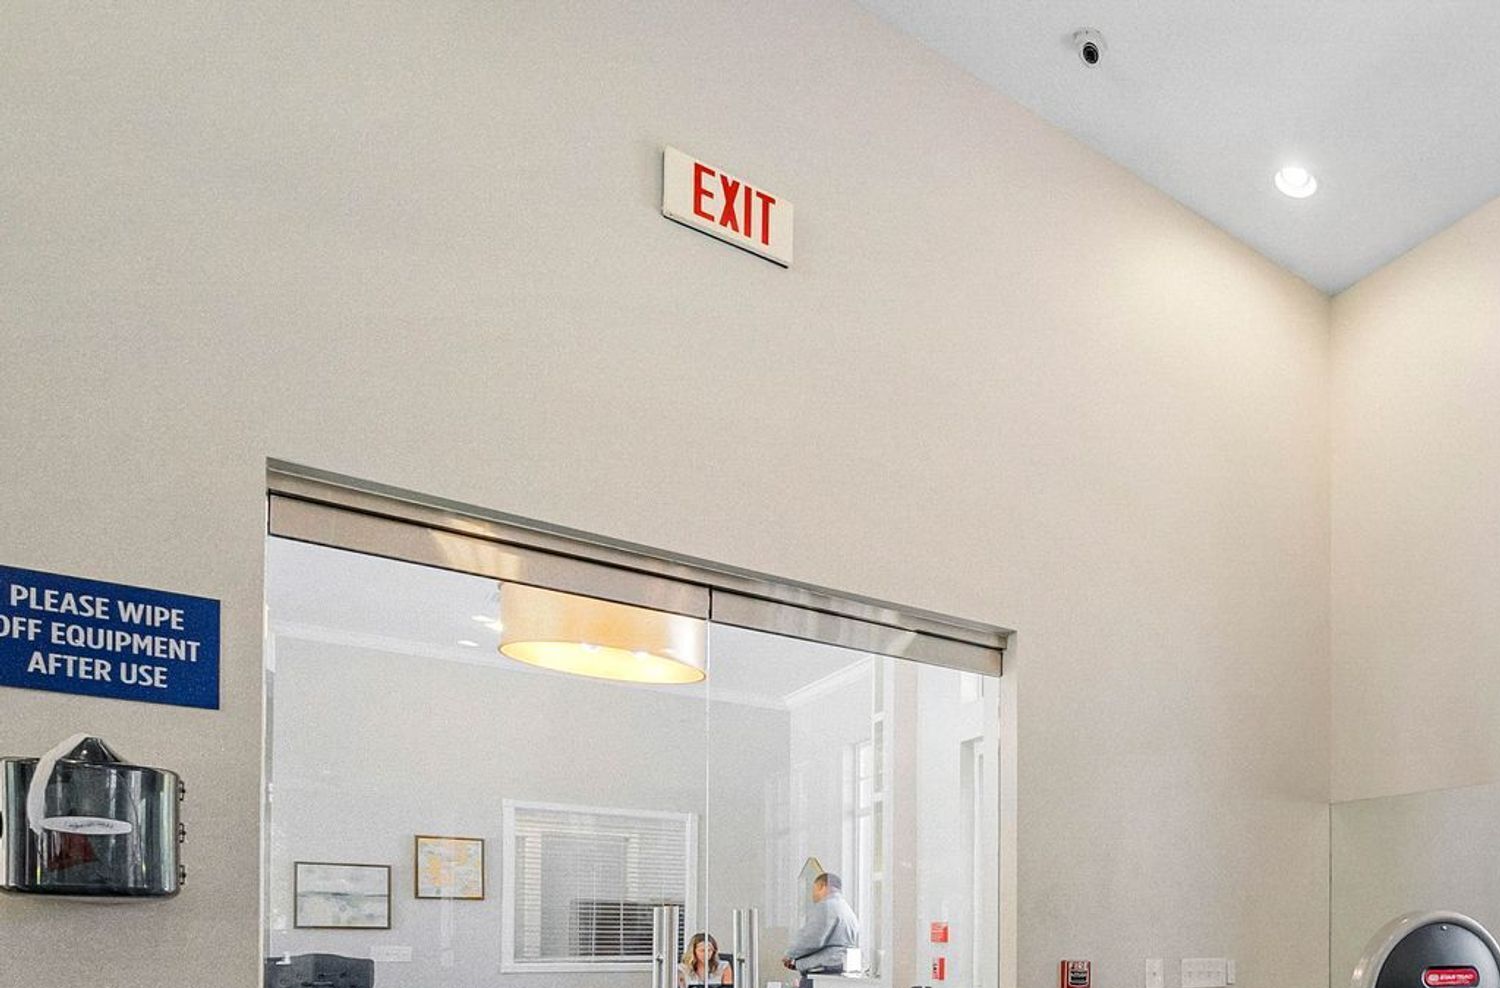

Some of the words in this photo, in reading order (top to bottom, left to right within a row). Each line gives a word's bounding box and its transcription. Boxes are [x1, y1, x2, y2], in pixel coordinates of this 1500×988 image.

[693, 162, 776, 246] EXIT
[10, 584, 110, 620] PLEASE
[117, 600, 185, 631] WIPE
[51, 622, 200, 662] EQUIPMENT
[27, 651, 112, 682] AFTER
[119, 662, 168, 688] USE
